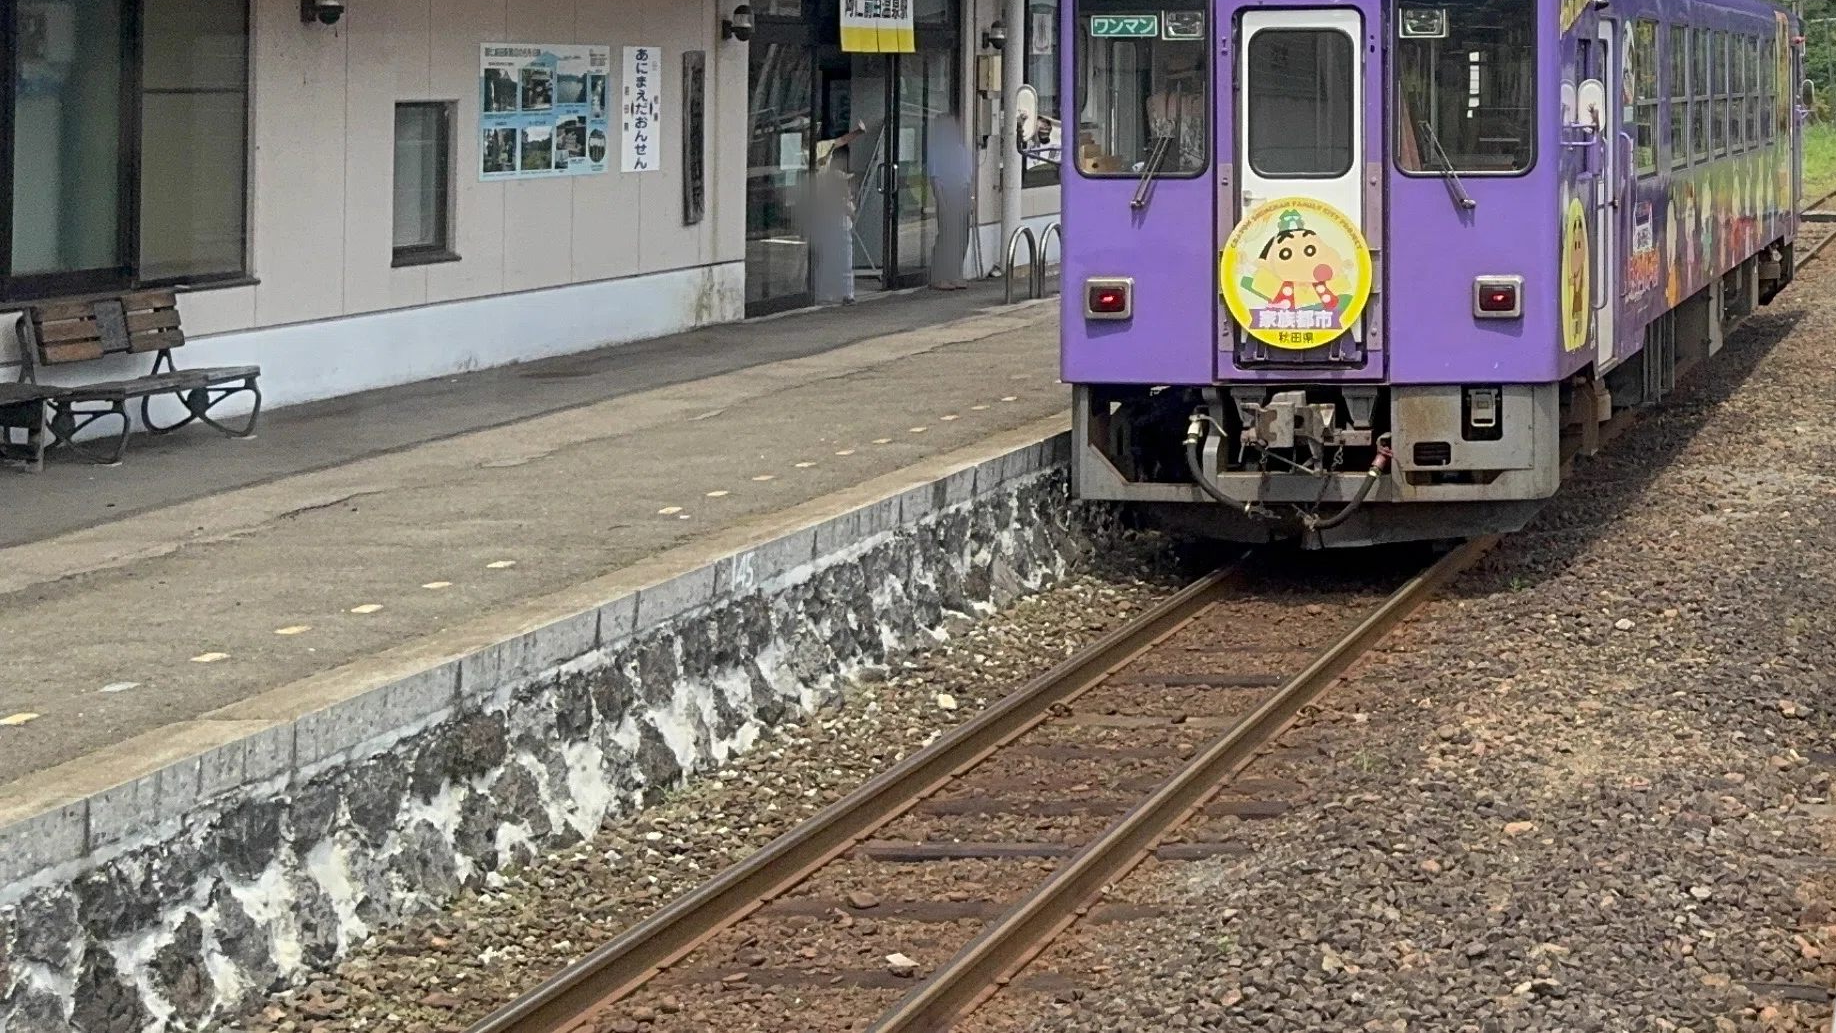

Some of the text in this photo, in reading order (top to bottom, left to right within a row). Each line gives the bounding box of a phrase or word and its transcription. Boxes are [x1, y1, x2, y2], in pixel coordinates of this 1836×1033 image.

[1094, 18, 1154, 34] ワンマン
[633, 48, 649, 170] あにまえだおんせん
[1258, 309, 1333, 328] 家族都市
[1278, 331, 1314, 344] 秋田県
